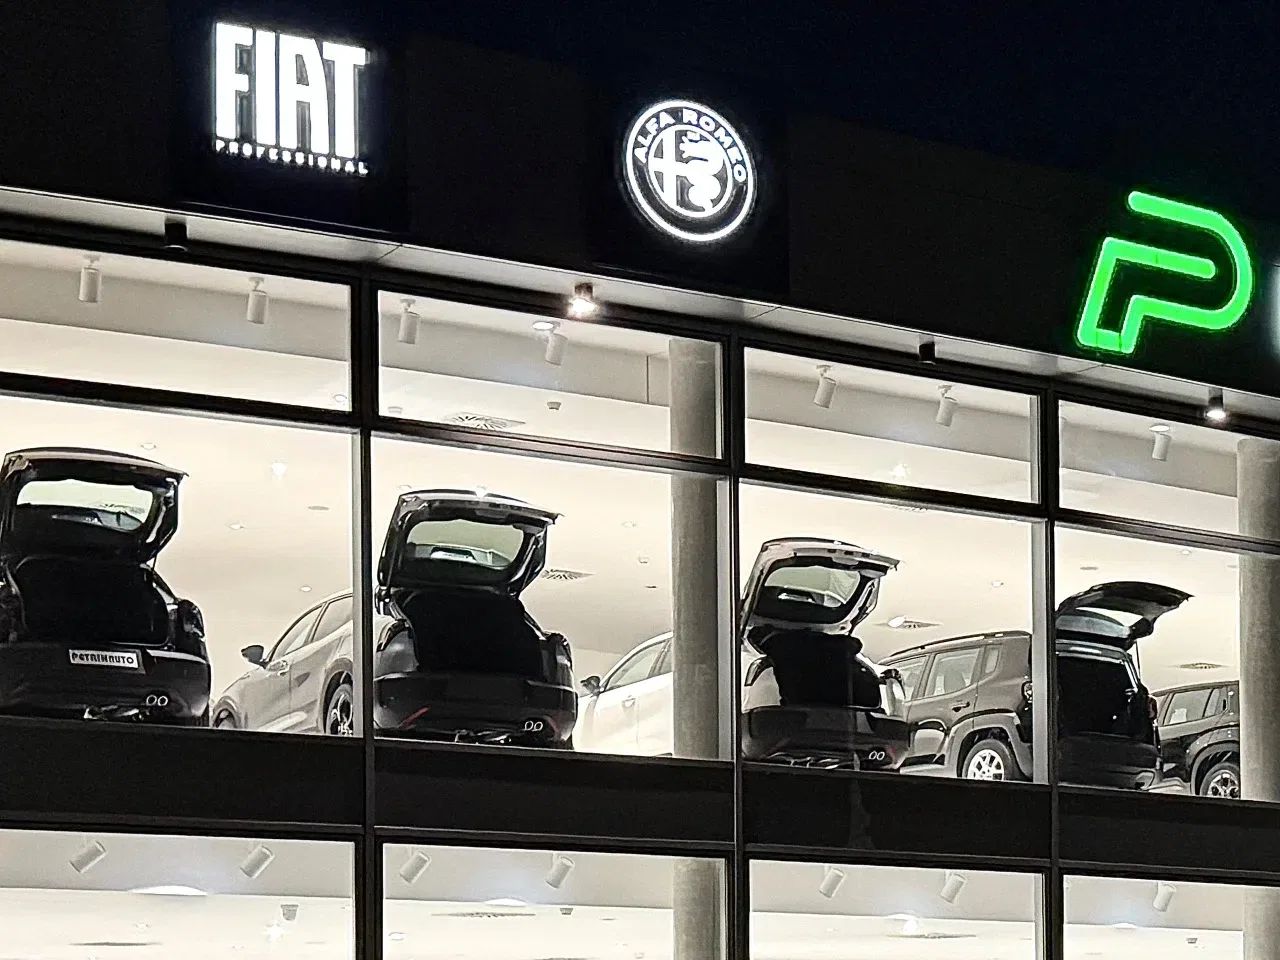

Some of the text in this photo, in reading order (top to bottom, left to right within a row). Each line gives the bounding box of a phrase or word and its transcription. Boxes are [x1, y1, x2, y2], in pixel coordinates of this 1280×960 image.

[214, 21, 367, 159] FIAT
[214, 139, 369, 177] PROFESSIONAL
[633, 108, 748, 183] ALFA ROMEO
